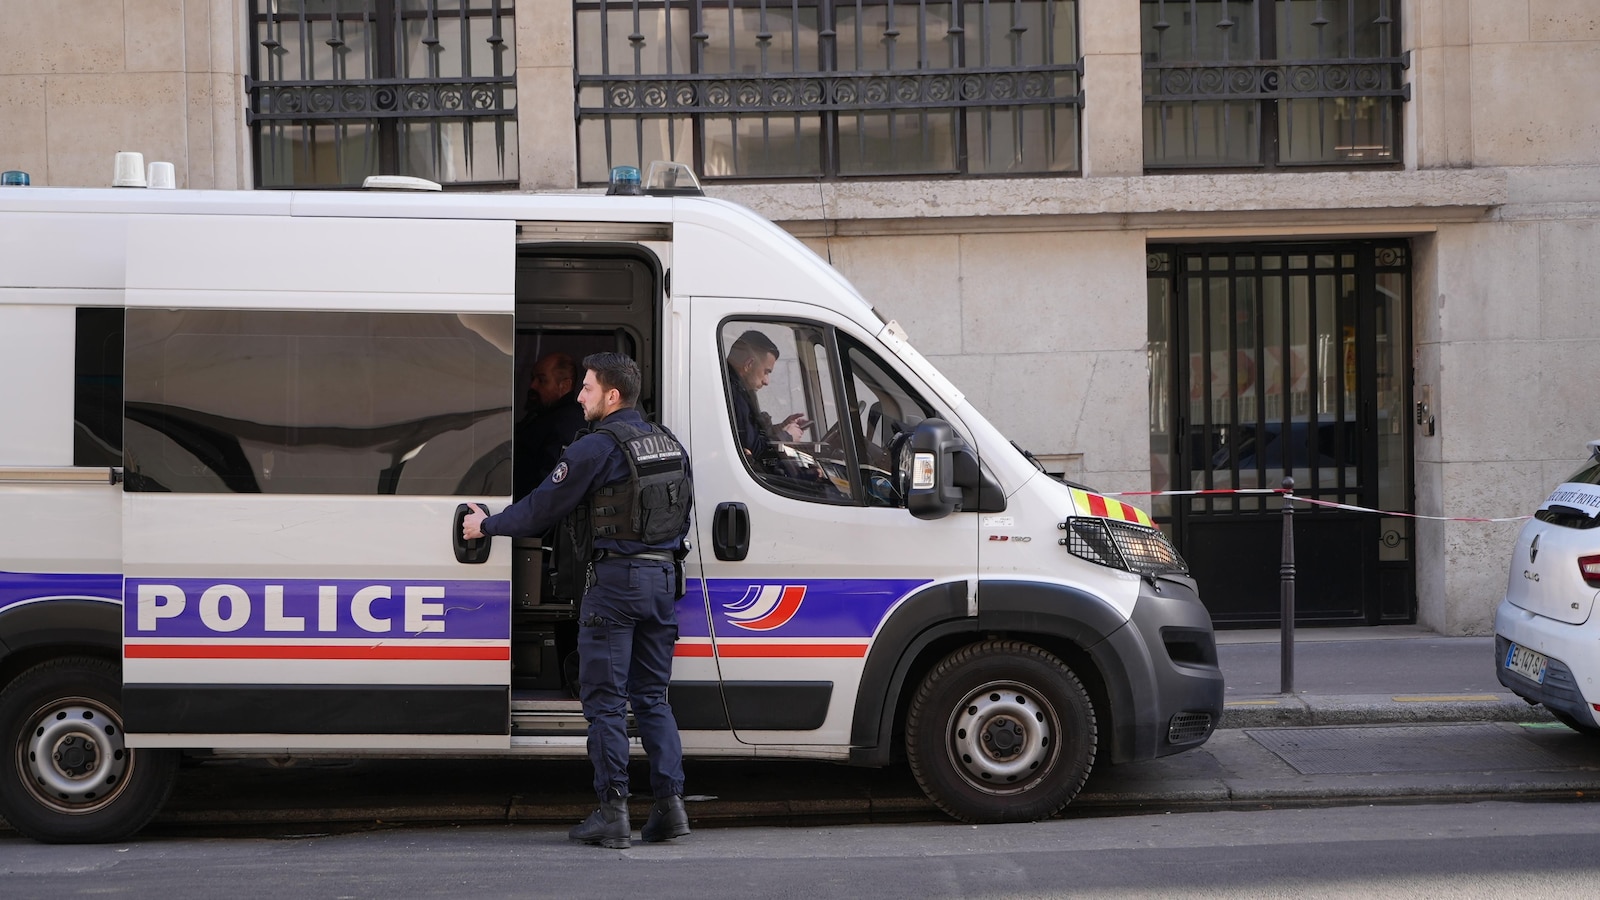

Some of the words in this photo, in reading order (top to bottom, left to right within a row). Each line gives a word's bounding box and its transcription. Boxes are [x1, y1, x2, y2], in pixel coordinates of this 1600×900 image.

[631, 435, 680, 456] POLICE
[1524, 570, 1540, 582] CLIO
[137, 584, 445, 632] POLICE
